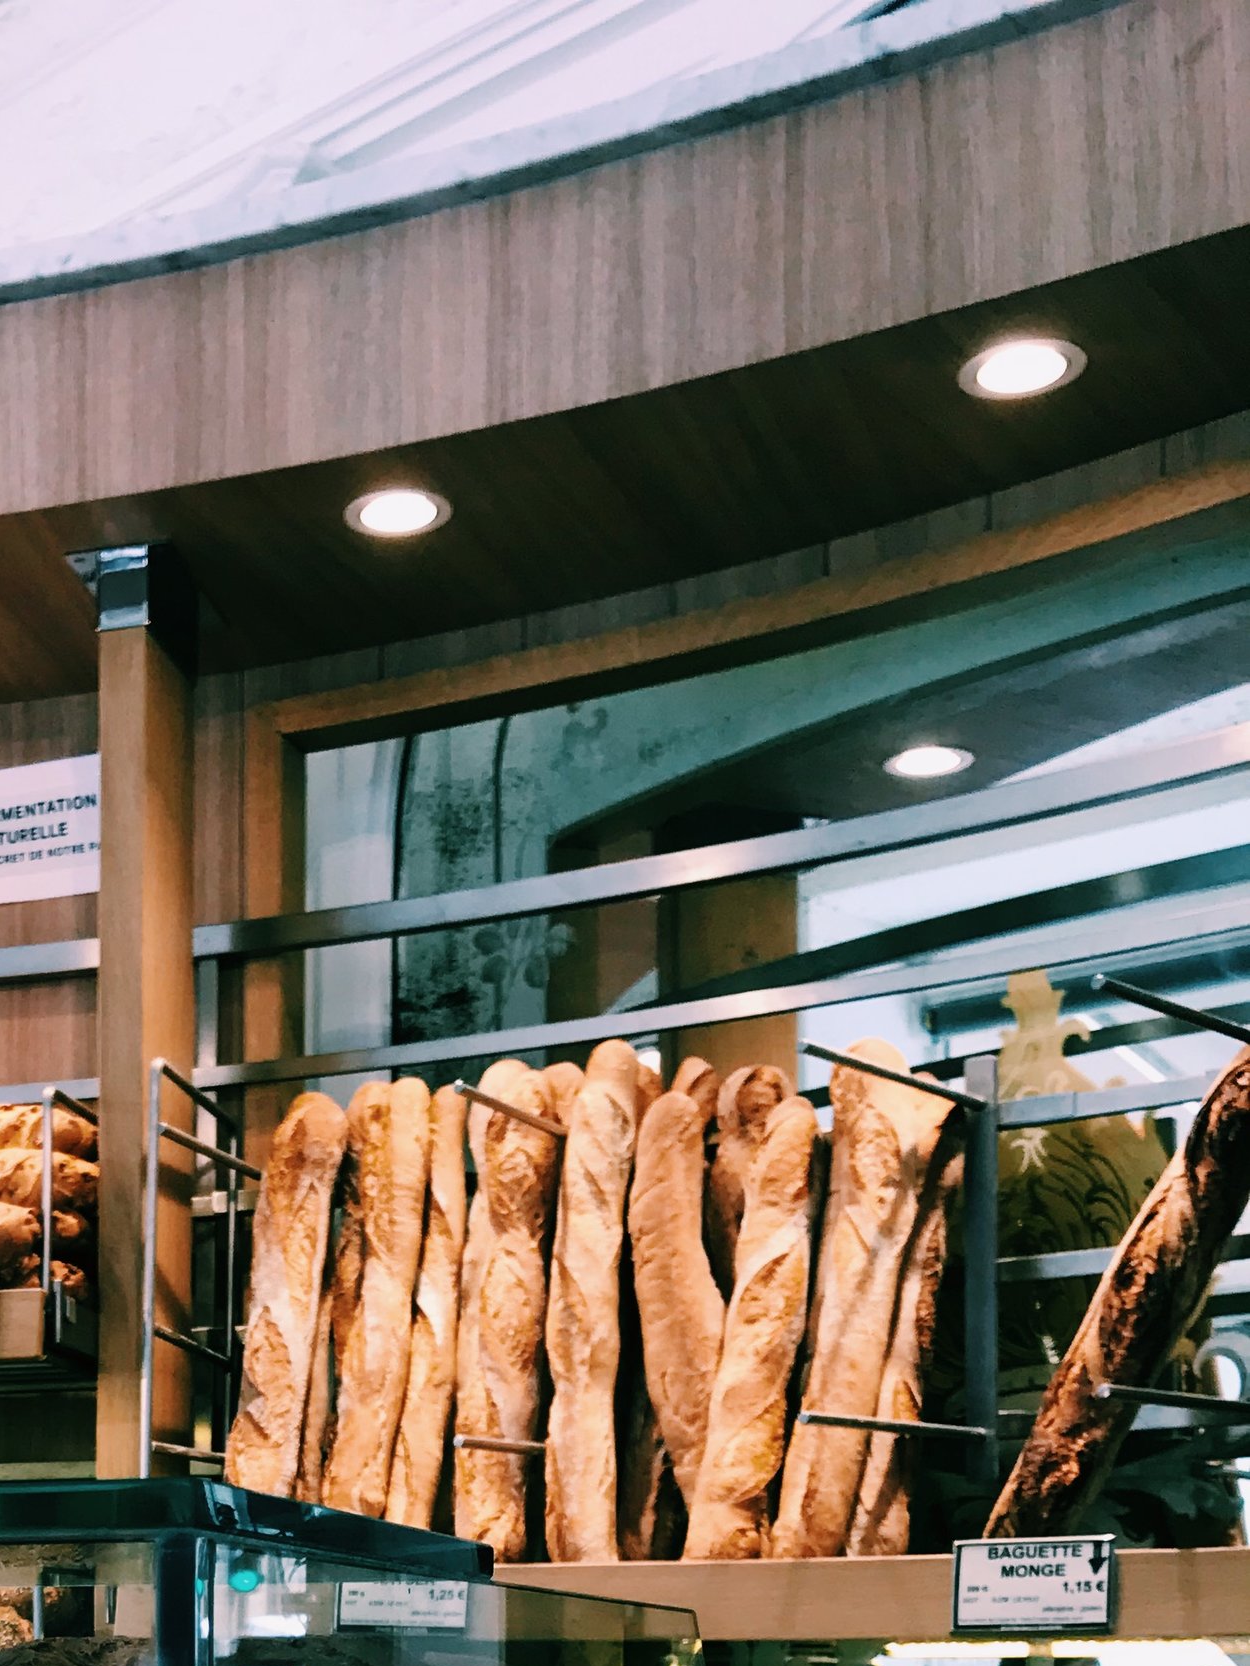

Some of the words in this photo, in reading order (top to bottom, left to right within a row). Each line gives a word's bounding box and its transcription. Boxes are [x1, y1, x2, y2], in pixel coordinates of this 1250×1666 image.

[987, 1544, 1083, 1560] BAGUETTE
[1000, 1563, 1067, 1578] MONGE
[1095, 1580, 1106, 1593] €
[457, 1589, 465, 1601] €
